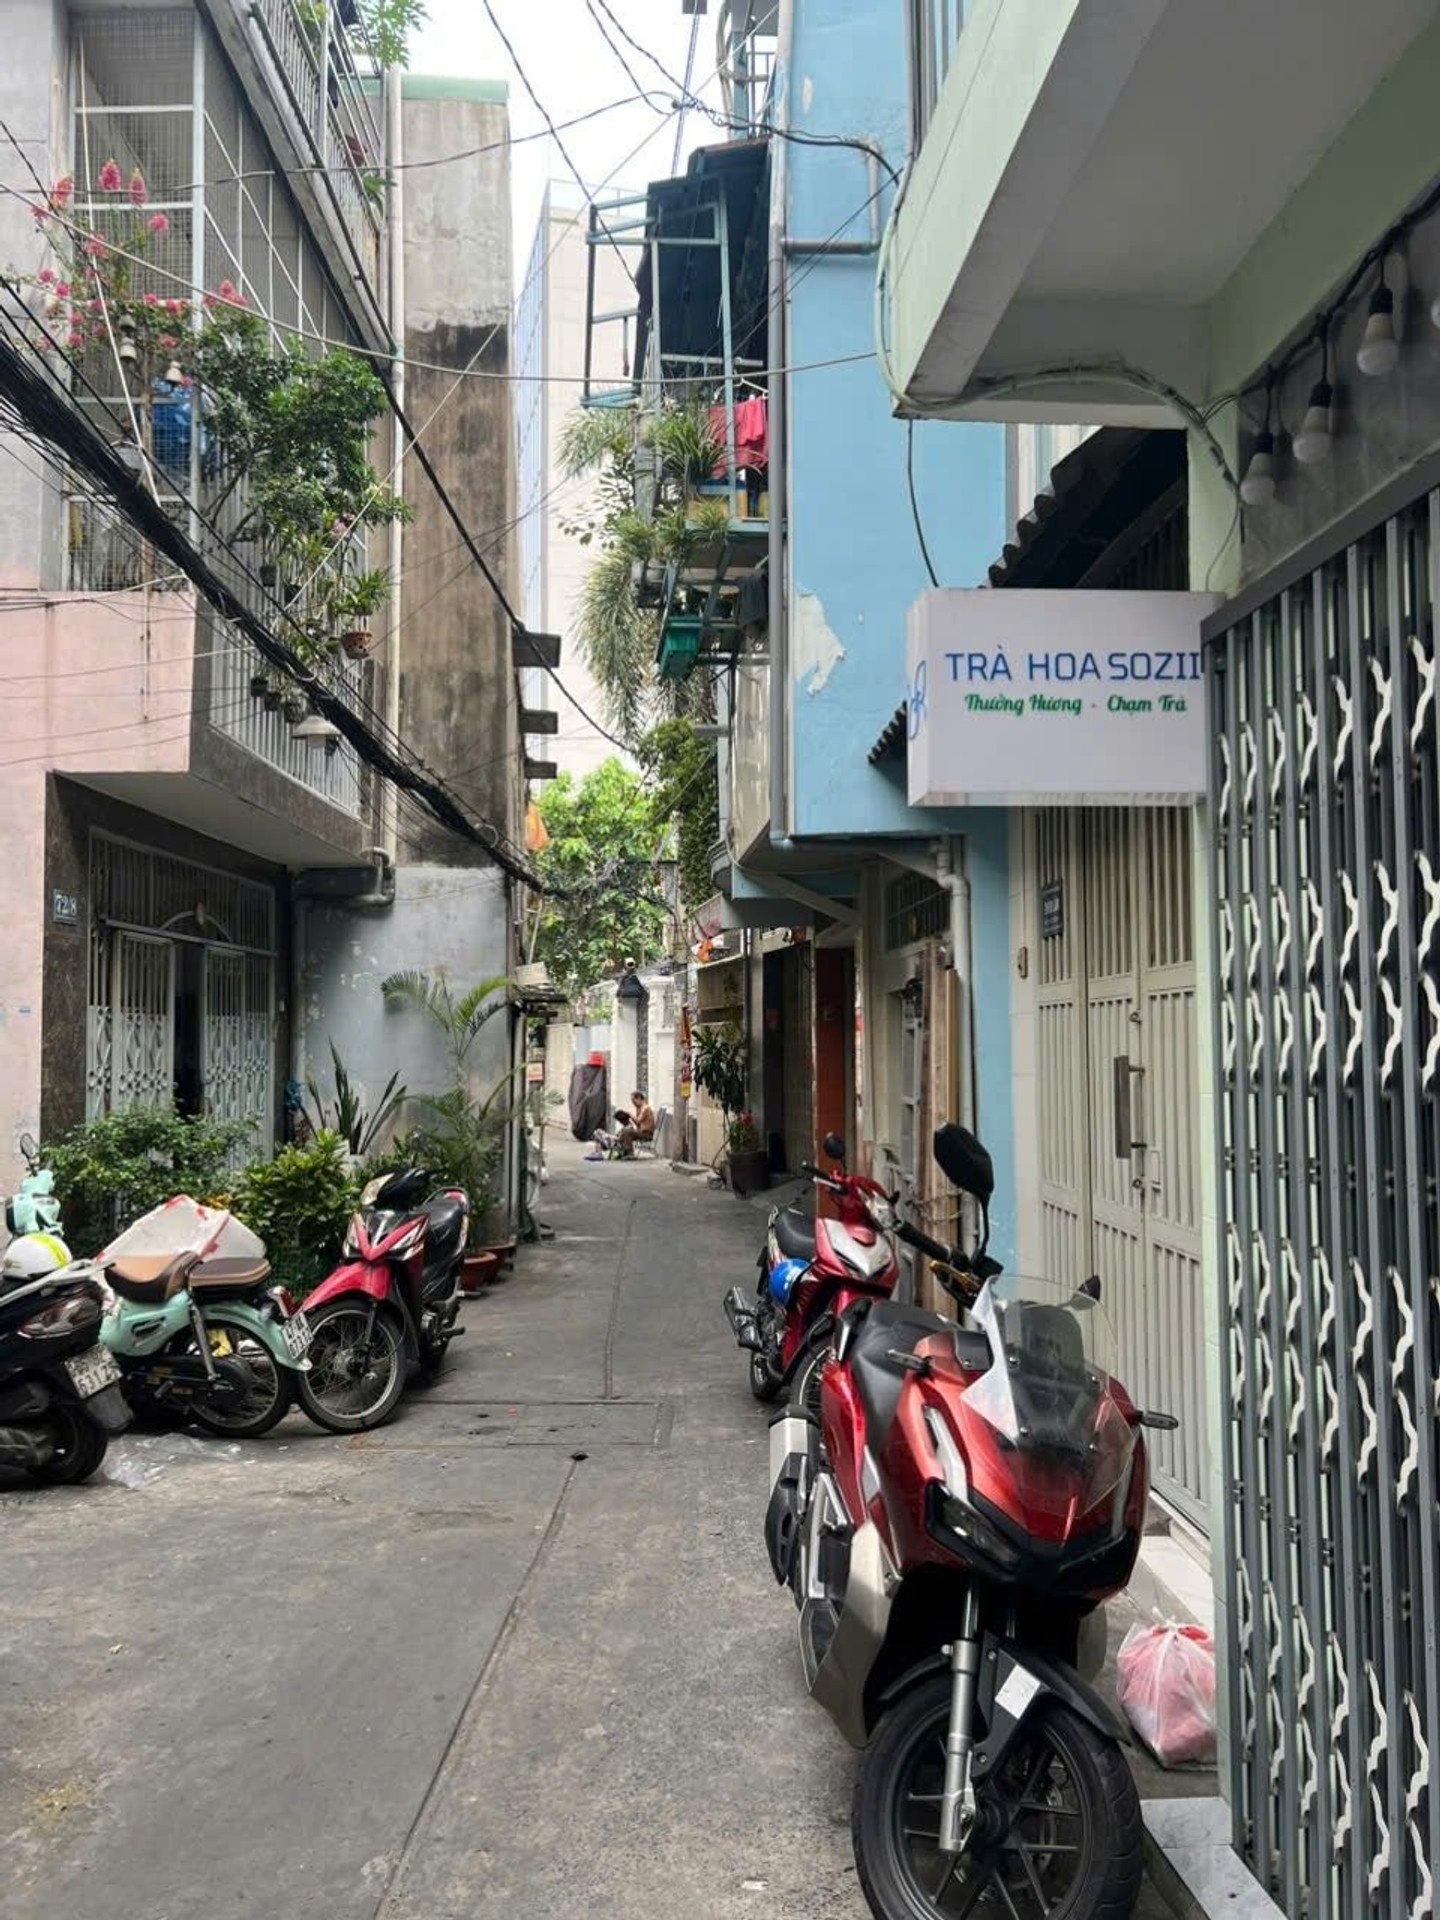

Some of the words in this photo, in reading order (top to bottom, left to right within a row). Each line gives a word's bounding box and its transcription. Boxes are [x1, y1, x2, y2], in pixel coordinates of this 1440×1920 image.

[945, 644, 1012, 681] TRÀ
[1028, 652, 1101, 681] HOA
[1108, 652, 1200, 681] SOZII
